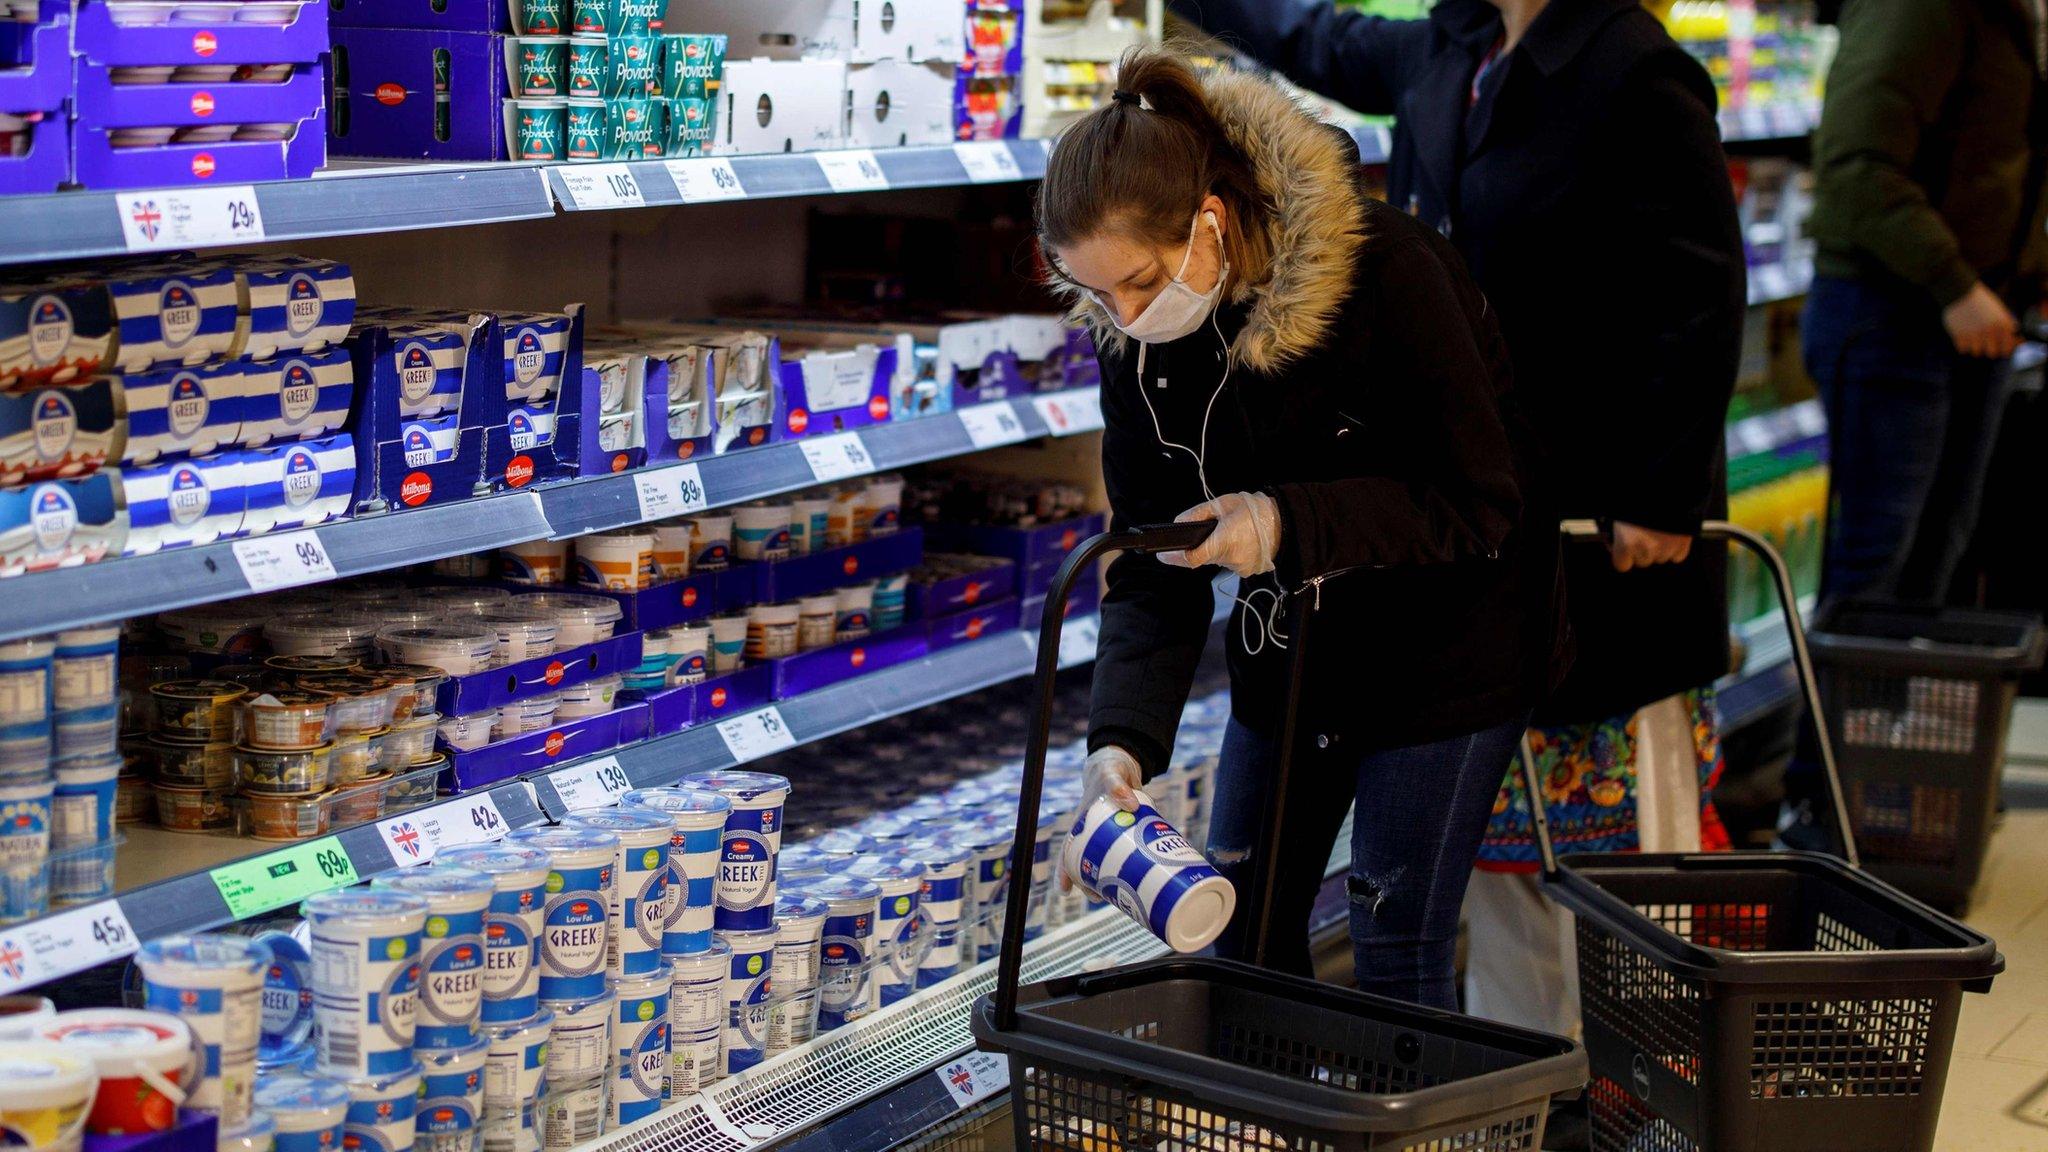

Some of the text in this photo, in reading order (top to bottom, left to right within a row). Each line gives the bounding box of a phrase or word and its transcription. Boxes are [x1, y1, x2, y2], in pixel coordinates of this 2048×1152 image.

[527, 3, 559, 12] Proviact
[574, 1, 605, 10] Proviact
[619, 0, 659, 17] Proviact
[524, 64, 557, 73] Proviact
[570, 64, 600, 75] Proviact
[616, 62, 655, 81] Proviact
[674, 60, 715, 79] Proviact
[522, 128, 555, 138] Proviact
[568, 126, 599, 136] Proviact
[614, 125, 653, 144] Proviact
[606, 174, 637, 198] 1.05
[292, 301, 314, 316] GREEK
[519, 354, 537, 368] GREEK
[406, 370, 427, 384] GREEK
[285, 389, 309, 404] GREEK
[513, 435, 529, 448] REEK
[401, 482, 431, 497] Milbona
[681, 479, 701, 504] 89p
[296, 542, 325, 567] 99p
[596, 765, 627, 793] 1.39
[471, 805, 499, 831] 42p
[316, 849, 349, 878] 69p
[727, 852, 755, 862] Creamy
[718, 865, 758, 882] REEK
[566, 915, 581, 924] Low
[550, 927, 597, 947] GREEK
[487, 951, 516, 970] EEK
[823, 957, 849, 965] Creamy
[433, 972, 478, 994] GREEK
[262, 991, 289, 1010] REEK
[641, 1050, 664, 1072] GREE
